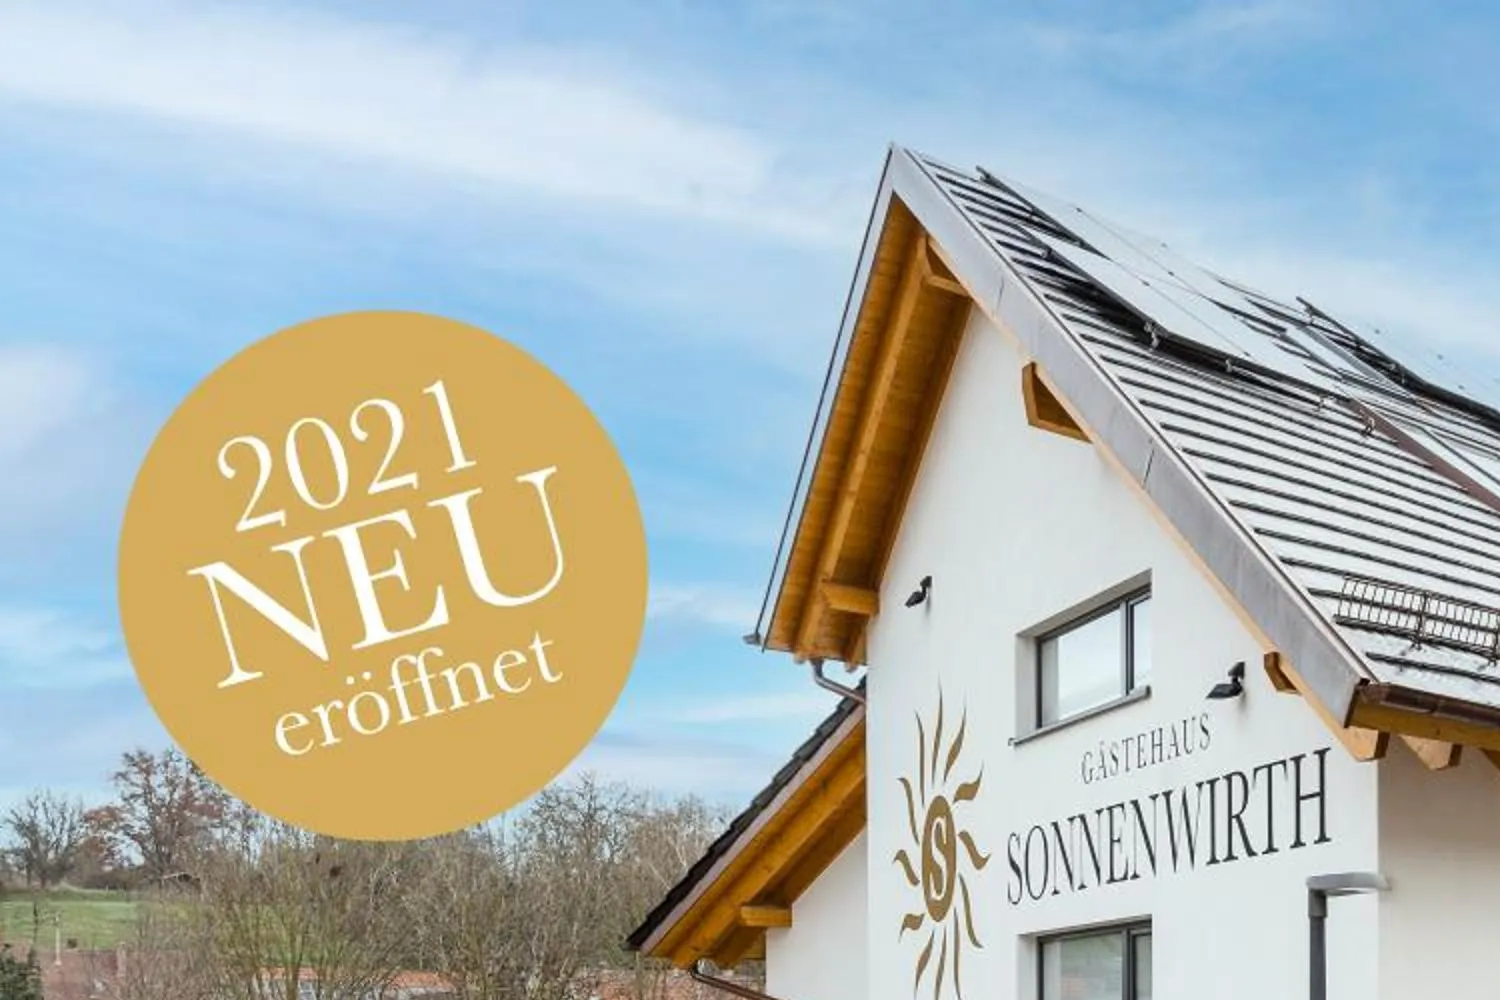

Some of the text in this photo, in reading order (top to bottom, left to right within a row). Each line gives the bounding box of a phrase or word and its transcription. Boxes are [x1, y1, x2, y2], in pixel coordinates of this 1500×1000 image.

[1081, 713, 1212, 784] GÄSTEHAUS
[929, 815, 948, 901] S
[1006, 747, 1332, 905] SONNENWIRTH
